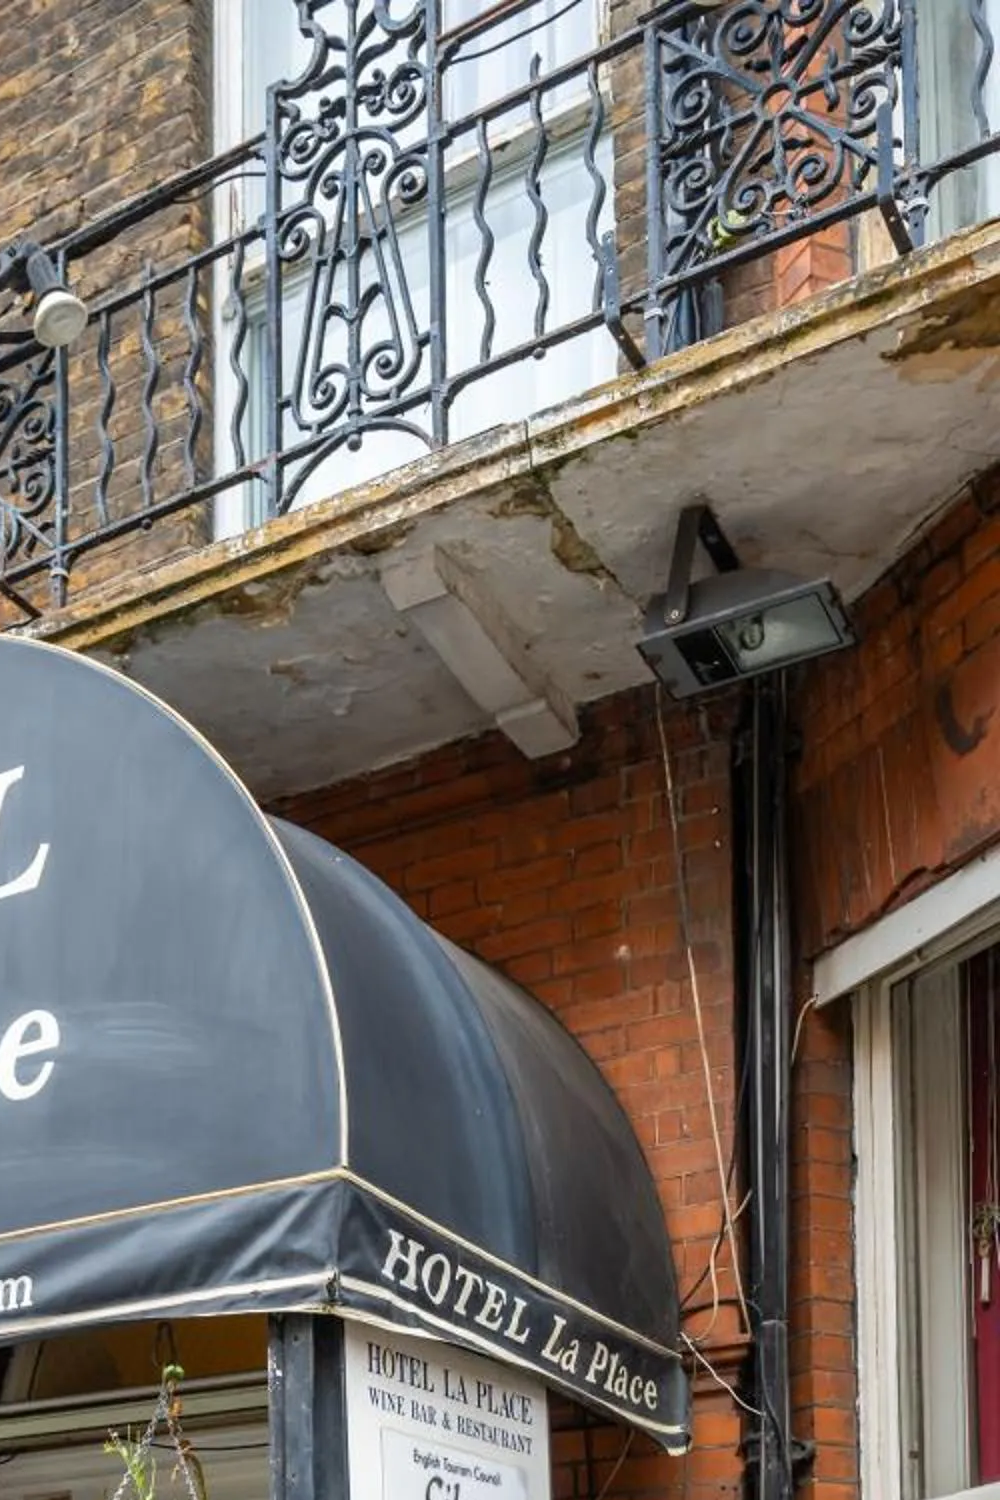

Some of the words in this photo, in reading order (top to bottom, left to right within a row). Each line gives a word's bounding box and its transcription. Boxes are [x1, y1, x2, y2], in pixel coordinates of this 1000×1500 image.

[381, 1228, 531, 1344] HOTEL
[541, 1314, 580, 1375] La
[585, 1341, 659, 1410] Place
[366, 1341, 435, 1393] HOTEL
[443, 1368, 468, 1405] LA
[476, 1379, 533, 1425] PLACE
[368, 1386, 405, 1417] WINE
[411, 1400, 437, 1426] BAR
[441, 1411, 452, 1430] &
[457, 1415, 533, 1455] RESTAURANT
[413, 1448, 440, 1470] English
